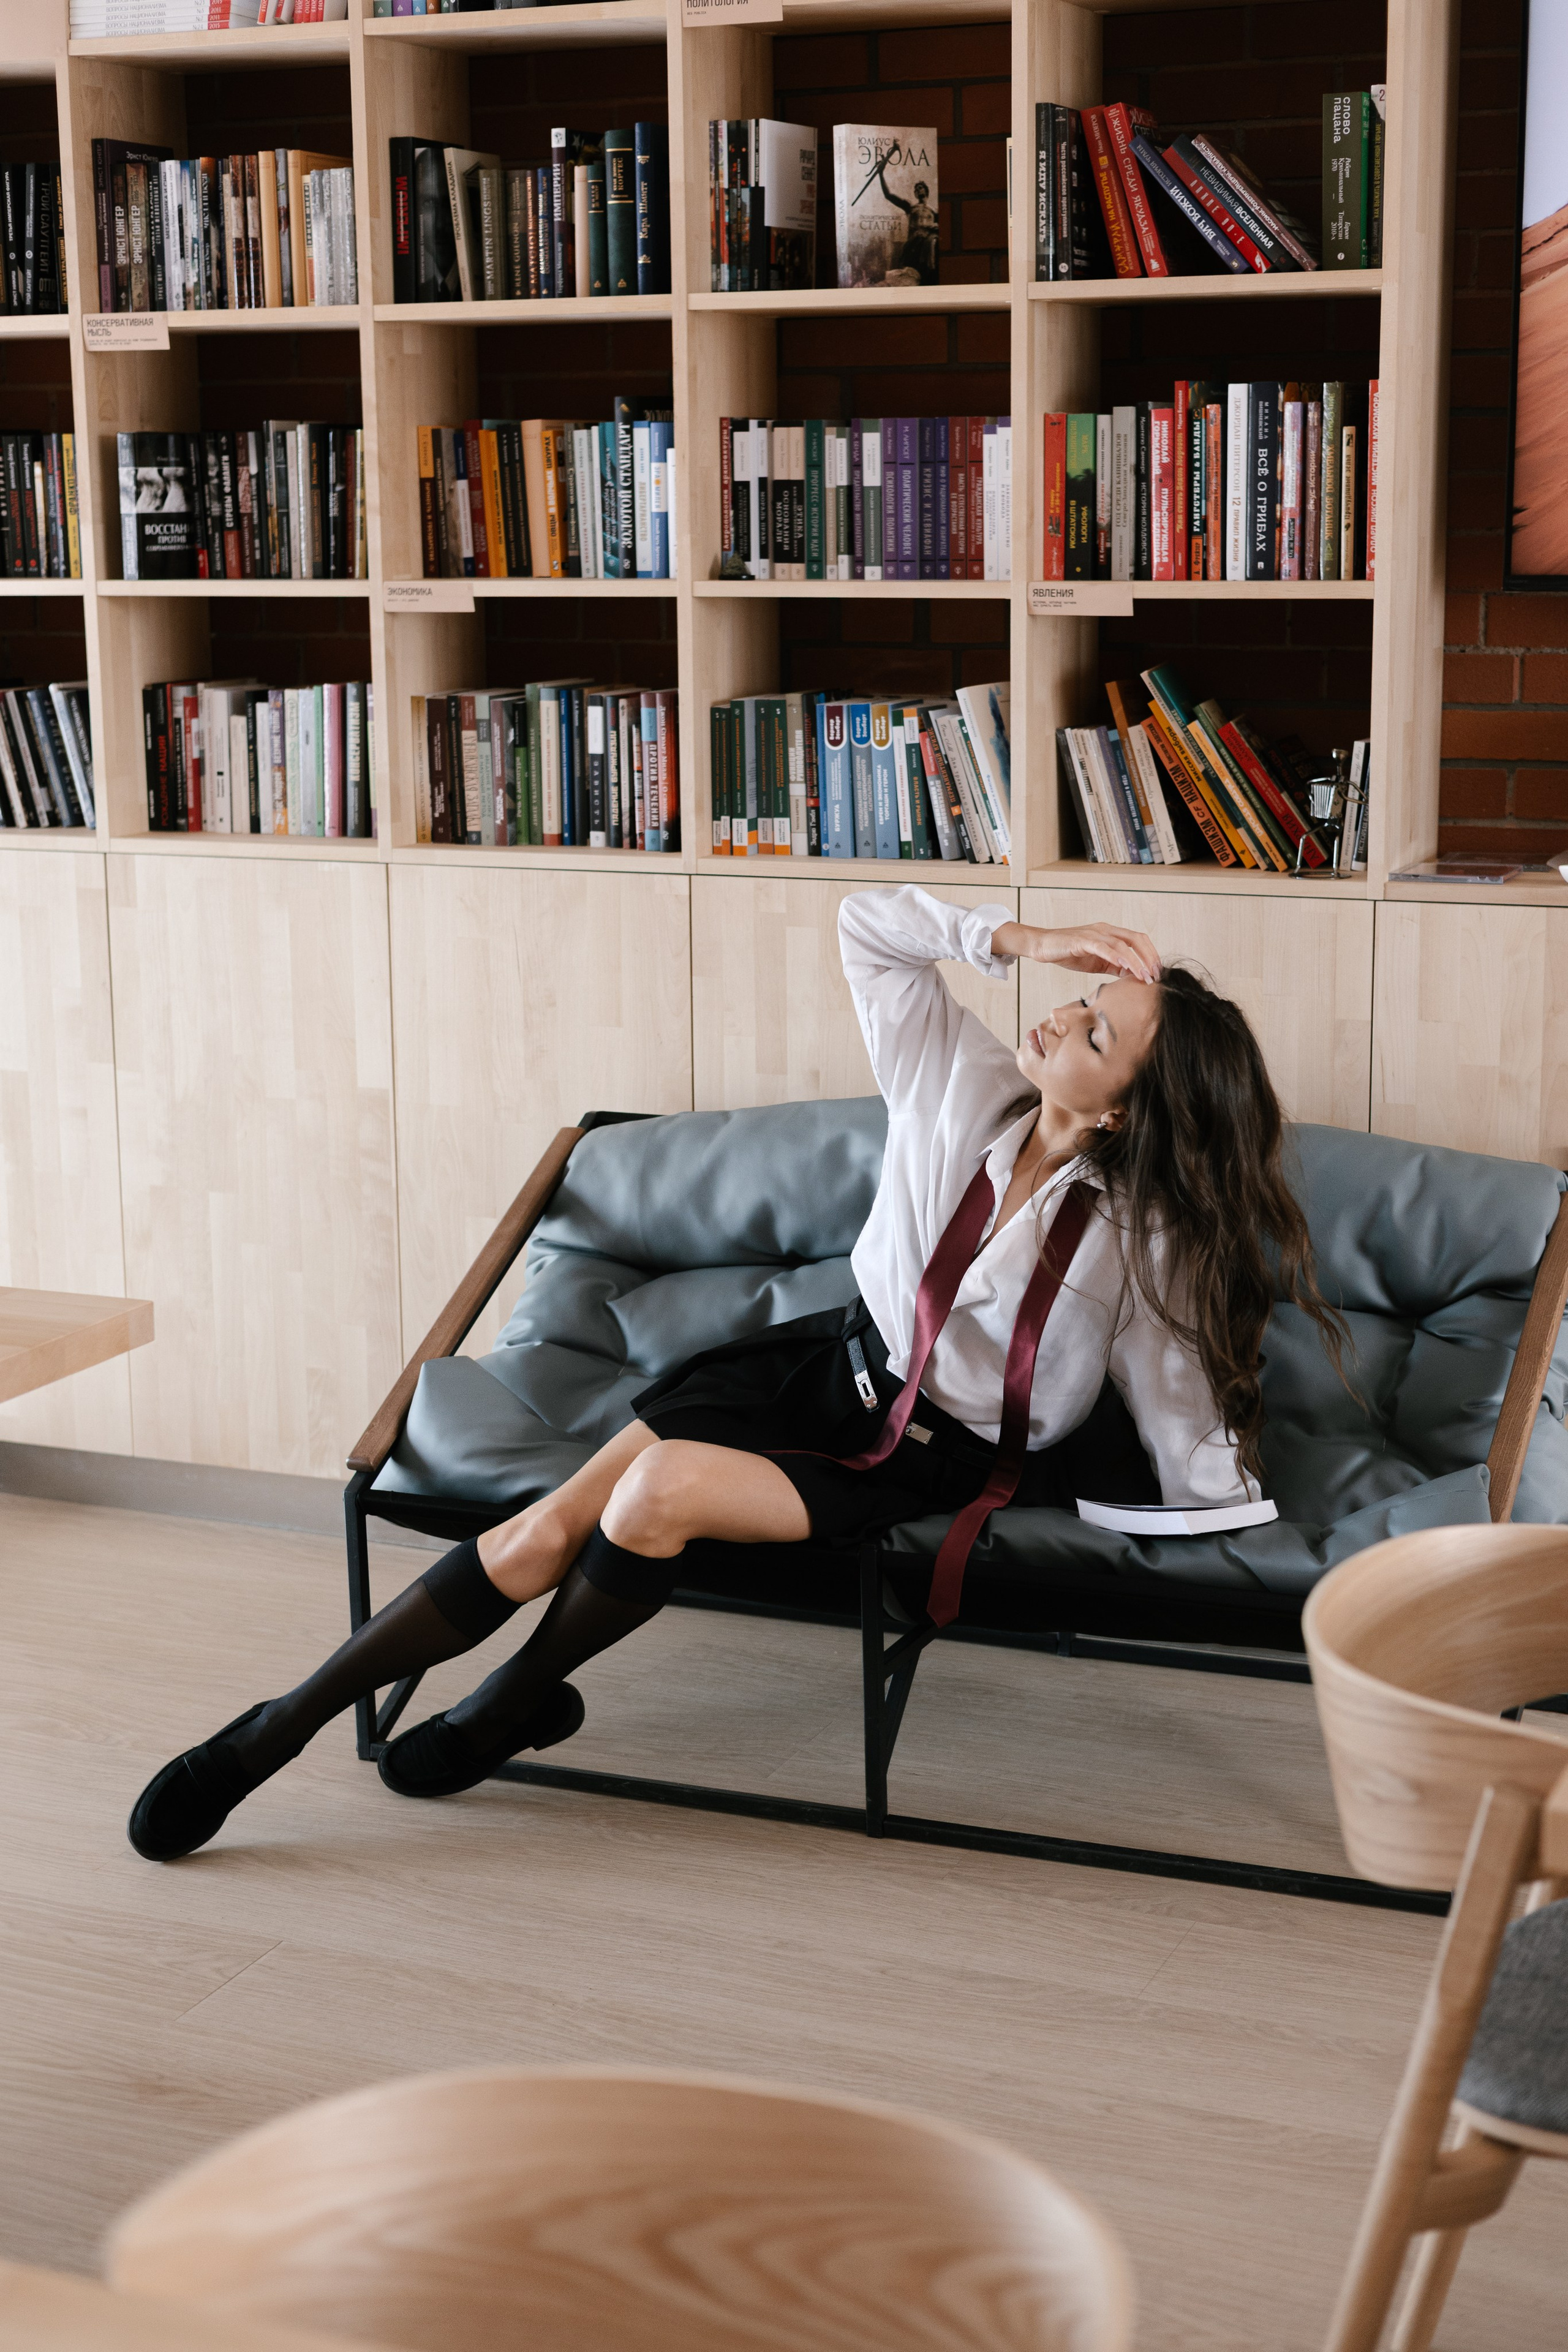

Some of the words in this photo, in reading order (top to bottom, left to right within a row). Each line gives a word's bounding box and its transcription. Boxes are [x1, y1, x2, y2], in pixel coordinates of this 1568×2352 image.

[1333, 97, 1343, 143] пацана
[858, 137, 890, 146] ЮЛИУС
[858, 146, 930, 167] ЭВОЛА
[1039, 150, 1046, 159] Я
[447, 161, 457, 201] АЛАДДИНА
[553, 164, 562, 222] ИМПЕРИИ
[1099, 172, 1114, 208] РАСПУТЬЕ
[1113, 118, 1126, 154] ЖИЗНЬ
[1123, 157, 1139, 192] СРЕДИ
[1132, 195, 1149, 233] ЯКУДЗА
[639, 181, 648, 213] Шмитт
[1108, 209, 1116, 221] НА
[1169, 186, 1204, 225] БОЖИЙ
[115, 206, 125, 236] ЮНГЕР
[131, 205, 141, 235] ЮНГЕР
[396, 176, 409, 255] IMPERIUM
[453, 202, 461, 240] ПРОБЛЕМА
[483, 201, 492, 233] LINGS
[639, 217, 650, 239] Карл
[859, 221, 902, 230] СТАТЬИ
[1197, 221, 1216, 241] БИЧ
[1236, 206, 1274, 249] ВСЕЛЕННАЯ
[116, 237, 127, 265] ЭРНСТ
[132, 237, 143, 264] ЭРНСТ
[485, 238, 494, 279] MARTIN
[1109, 222, 1129, 273] САМУРАЙ
[87, 318, 154, 327] КОНСЕРВАТИВНАЯ
[618, 421, 633, 486] СТАНДАРТ
[1258, 448, 1269, 476] ВСЁ
[221, 455, 231, 493] ФАЛАНГИ
[923, 467, 932, 498] КРИЗИС
[1258, 481, 1267, 491] О
[886, 471, 895, 514] ПСИХОЛОГИЯ
[903, 469, 912, 523] ПОЛИТИЧЕСКИЙ
[1232, 497, 1241, 507] 12
[224, 496, 234, 527] СТРЕЛЫ
[617, 490, 633, 549] ЗОЛОТОЙ
[638, 481, 647, 541] ЛИБЕРТАРИАНСТВО
[1256, 497, 1267, 552] ГРИБАХ
[886, 517, 895, 552] ПОЛИТИКИ
[903, 525, 911, 556] ЧЕЛОВЕК
[923, 513, 932, 556] ЛЕВИАФАН
[388, 587, 433, 596] ЭКОНОМИКА
[1033, 589, 1074, 597] ЯВЛЕНИЯ
[158, 735, 167, 771] НАЦИИ
[349, 701, 360, 782] КОНСЕРВАТИЗМ
[609, 731, 619, 783] БУРЖУАЗИИ
[795, 729, 804, 782] РУКОВОДИТЕЛЯ
[927, 727, 941, 752] КРИЗИС
[649, 745, 658, 781] ПРОТИВ
[788, 747, 796, 782] ФУНКЦИИ
[935, 753, 956, 803] ПЕРМАНЕНТНЫЙ
[160, 775, 169, 826] РОЖДЕНИЕ
[935, 780, 949, 834] ПРОТЕКЦИОНИЗМ
